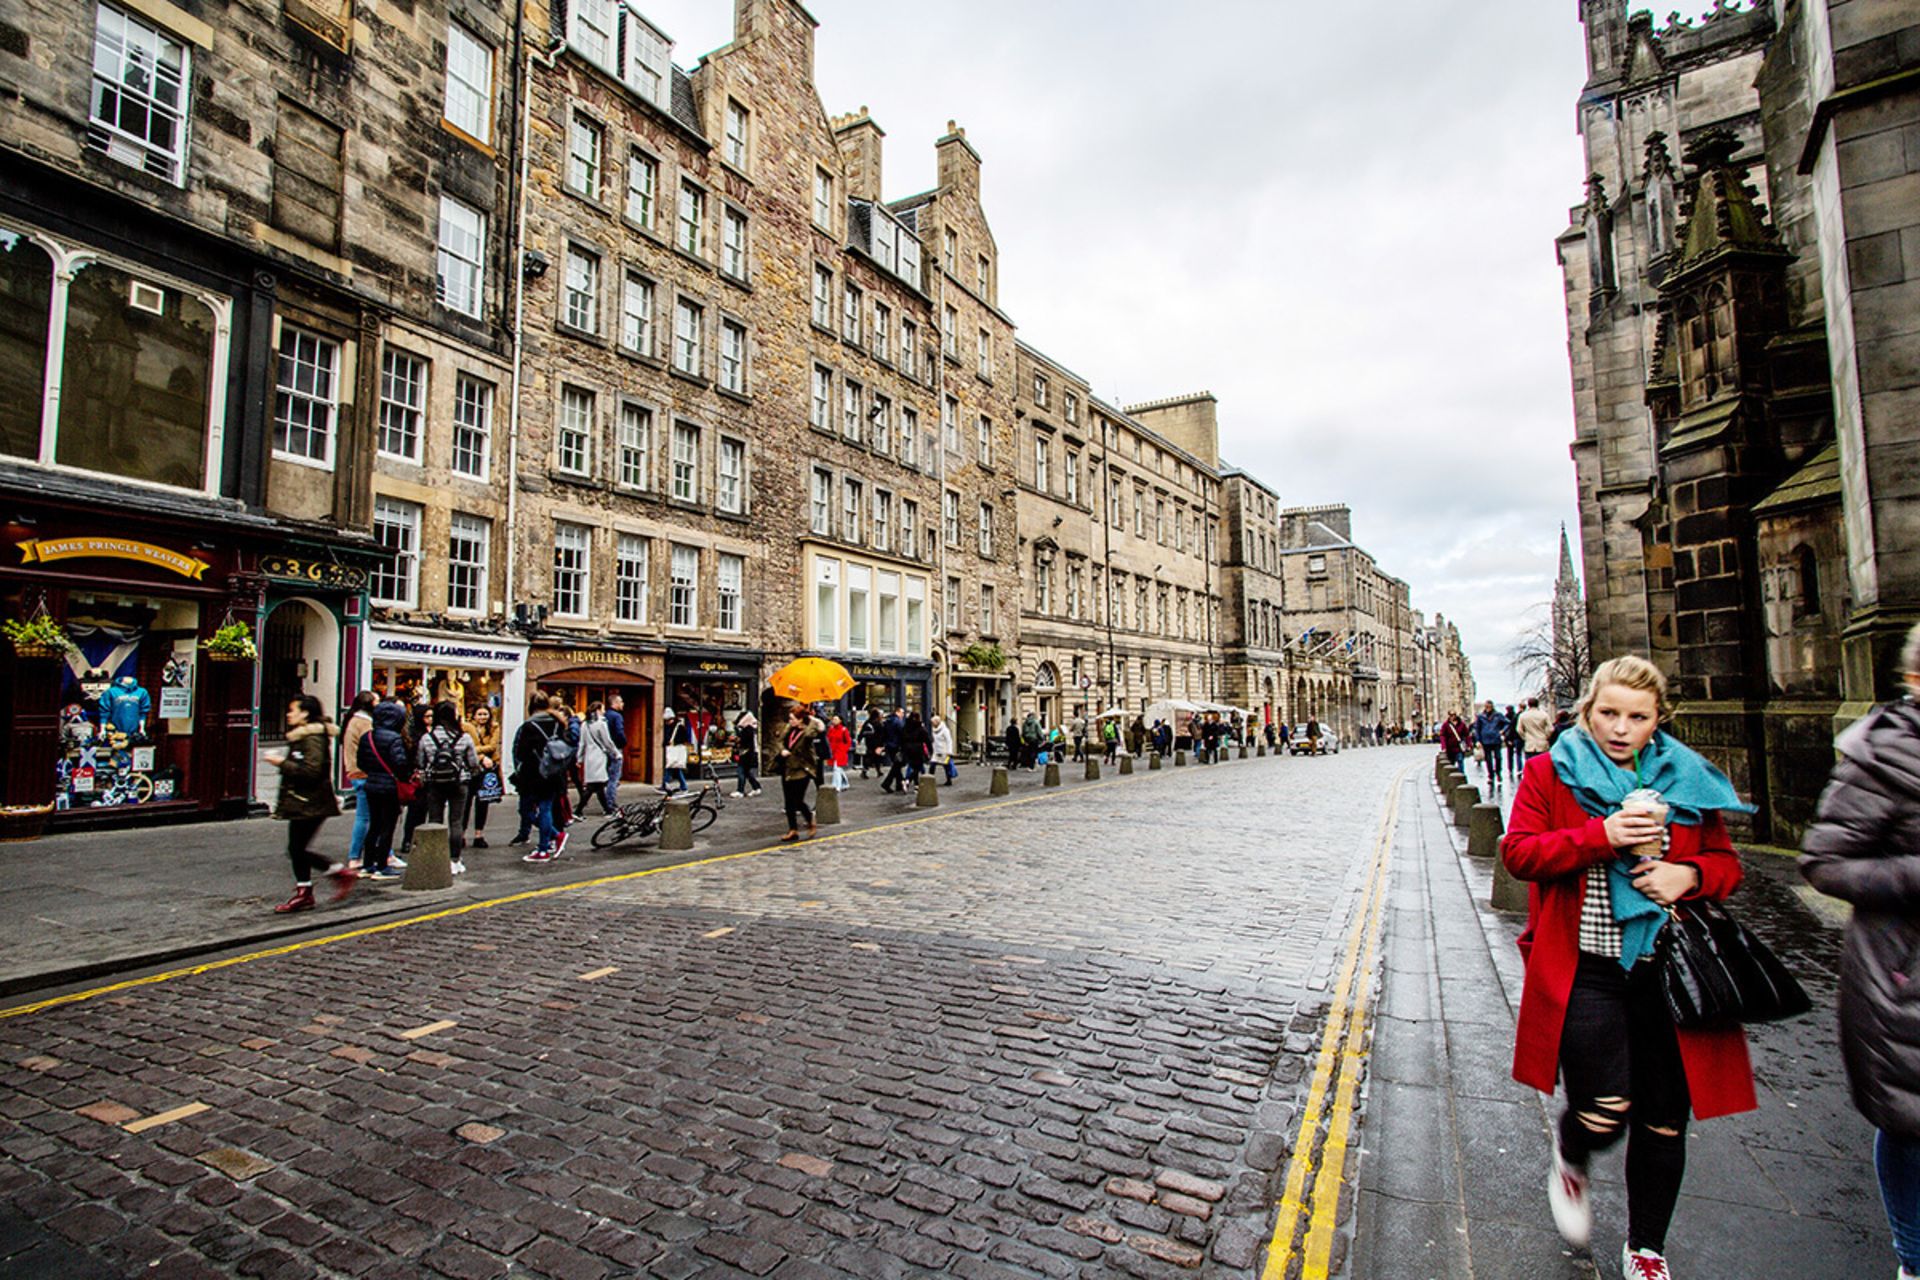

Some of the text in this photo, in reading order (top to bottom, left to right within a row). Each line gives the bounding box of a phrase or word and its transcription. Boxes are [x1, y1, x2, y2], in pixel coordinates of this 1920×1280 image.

[45, 541, 191, 571] JAMES PRINGLE WEAVERS
[378, 639, 520, 661] CASHMERE & LAMBSWOOL STORE
[572, 650, 632, 664] JEWELLERS
